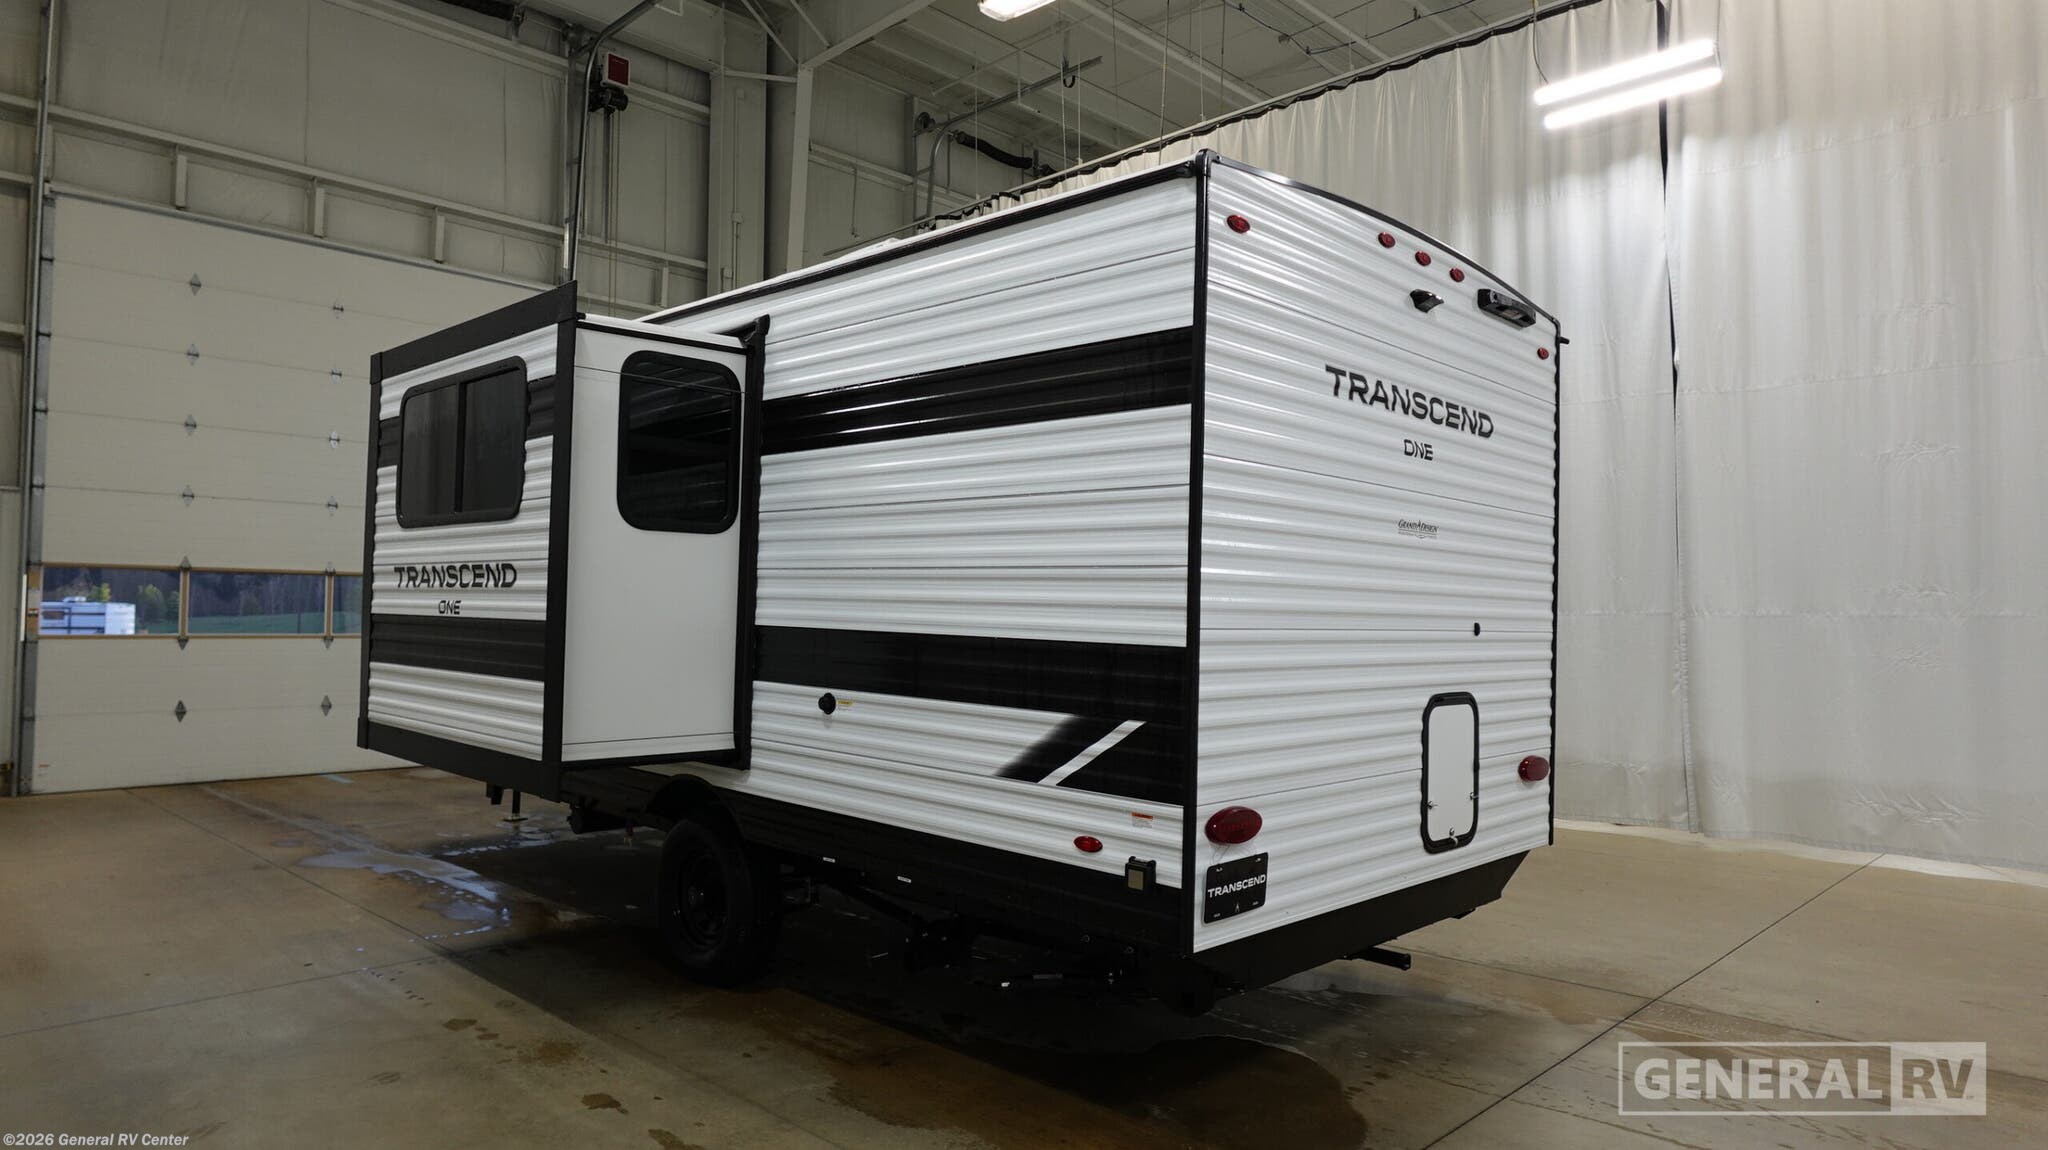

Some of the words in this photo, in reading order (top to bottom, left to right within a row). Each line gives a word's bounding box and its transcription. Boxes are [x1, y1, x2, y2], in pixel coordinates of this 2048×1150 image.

[1325, 364, 1494, 438] TRANSCEND
[394, 563, 517, 588] TRANSCEND
[438, 600, 461, 615] ONE
[1207, 874, 1266, 898] TRANSCEND
